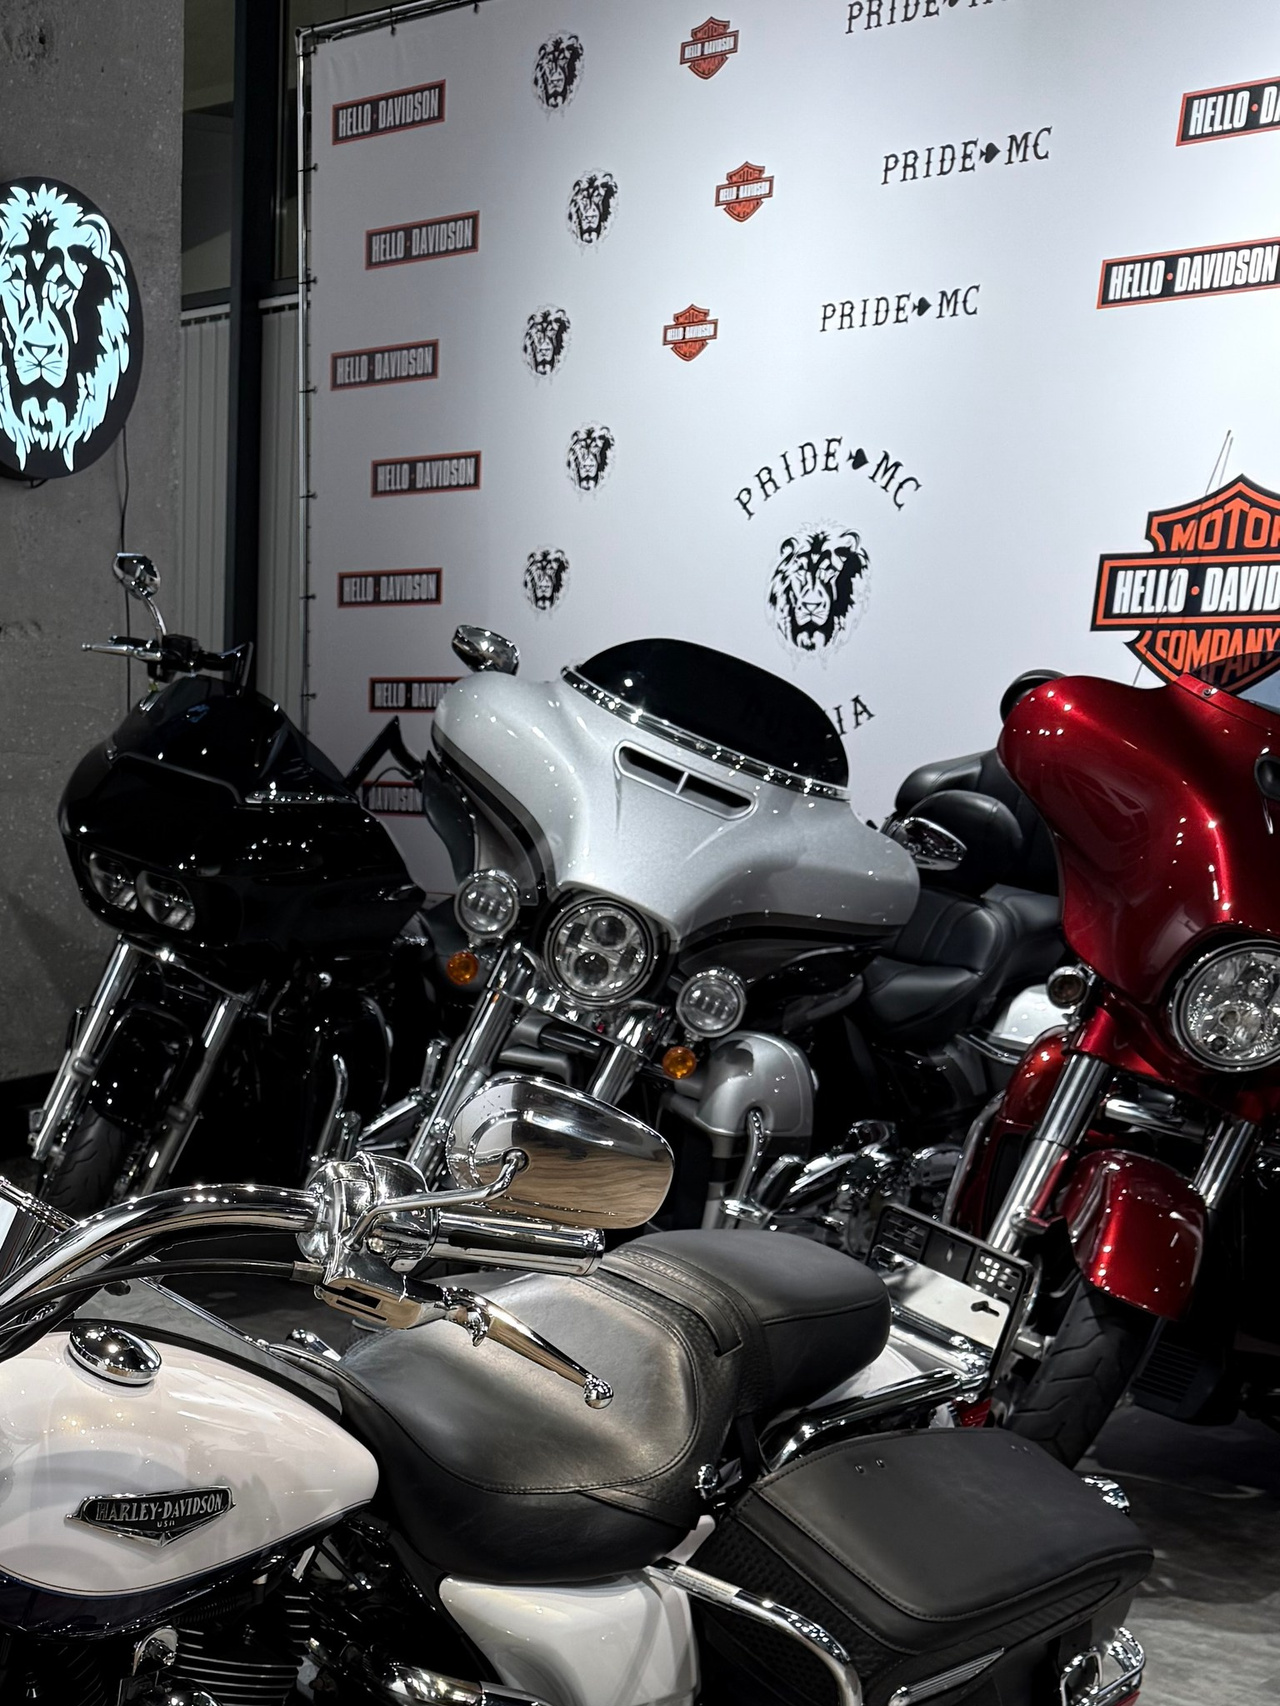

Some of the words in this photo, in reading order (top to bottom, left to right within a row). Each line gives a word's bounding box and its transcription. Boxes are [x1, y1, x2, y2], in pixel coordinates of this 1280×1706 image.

[338, 103, 372, 138] HELLO
[378, 87, 439, 129] DAVIDSON
[1188, 90, 1250, 136] HELLO
[880, 138, 979, 185] PRIDE
[1004, 126, 1053, 165] MC
[371, 230, 405, 263] HELLO
[411, 218, 473, 256] DAVIDSON
[1108, 258, 1166, 300] HELLO
[1173, 244, 1280, 293] DAVIDSON
[820, 292, 912, 332] PRIDE
[936, 284, 981, 319] MC
[336, 355, 369, 385] HELLO
[374, 345, 433, 380] DAVIDSON
[377, 463, 410, 492] HELLO
[415, 457, 476, 489] DAVIDSON
[733, 436, 843, 520] PRIDE
[867, 450, 923, 511] MC
[343, 576, 374, 603] HELLO
[380, 573, 437, 601] DAVIDSON
[1112, 567, 1189, 614] HELLO
[1155, 627, 1280, 684] COMPANY
[374, 682, 406, 708] HELLO
[95, 1492, 224, 1521] HARLEY-DAVIDSON
[156, 1520, 176, 1528] USA
